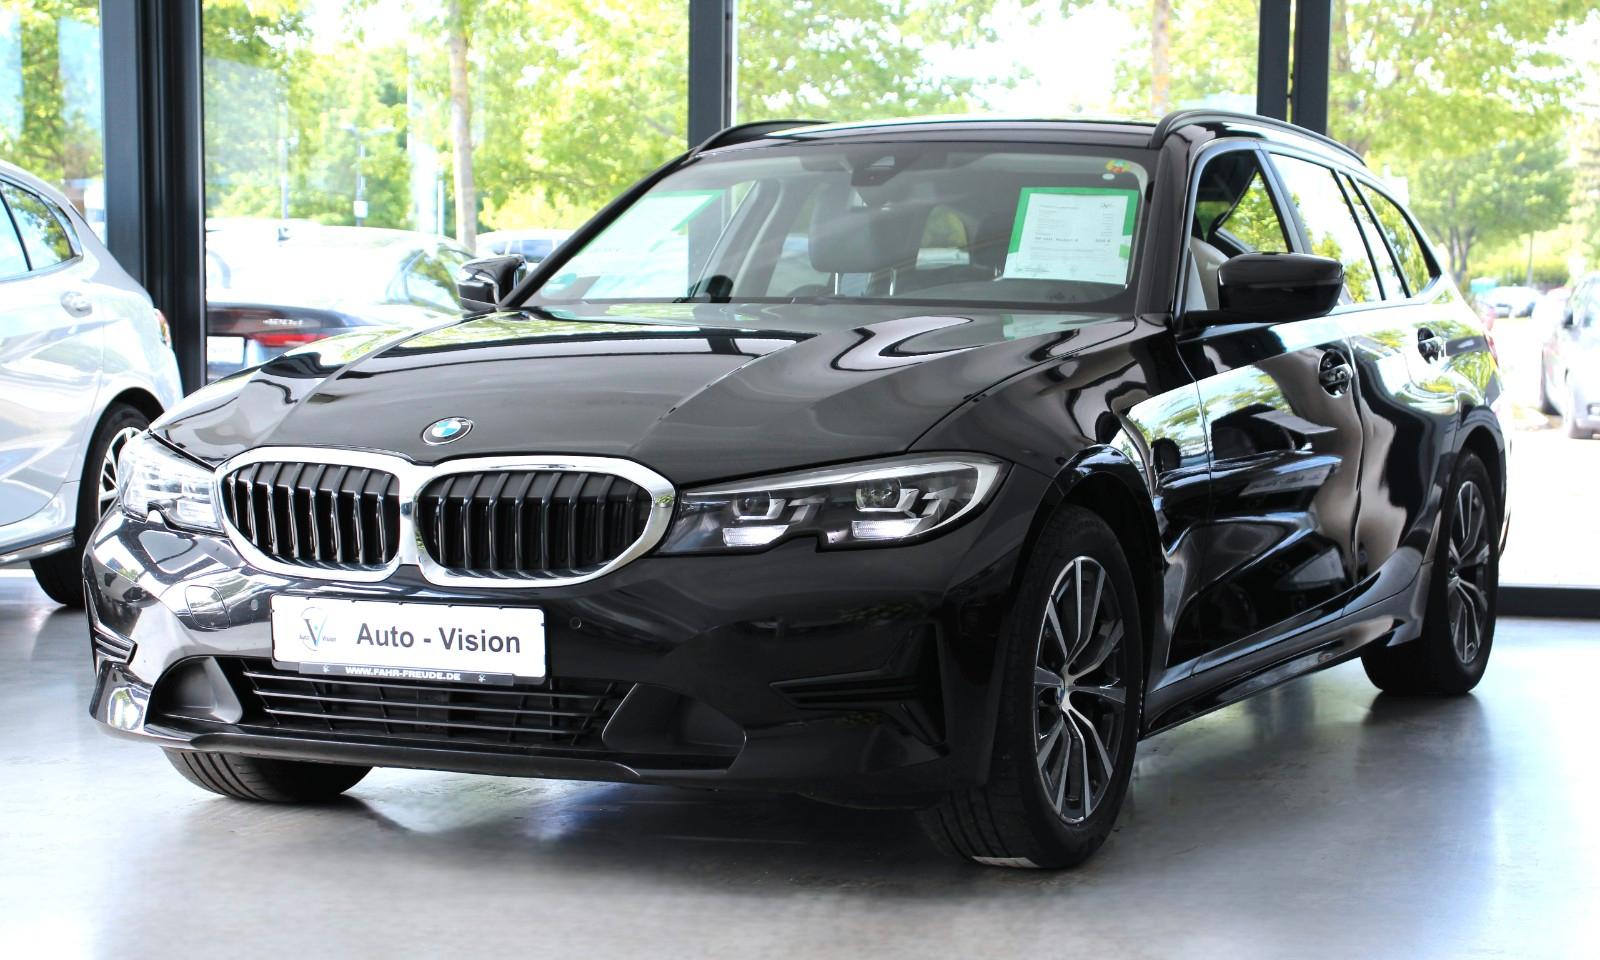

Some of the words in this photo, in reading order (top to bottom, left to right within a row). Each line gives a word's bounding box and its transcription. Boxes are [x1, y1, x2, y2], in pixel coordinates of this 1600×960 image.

[356, 622, 414, 648] Auto
[438, 627, 521, 654] Vision
[344, 666, 461, 680] WWW.FAHR-FREUDE.DE
